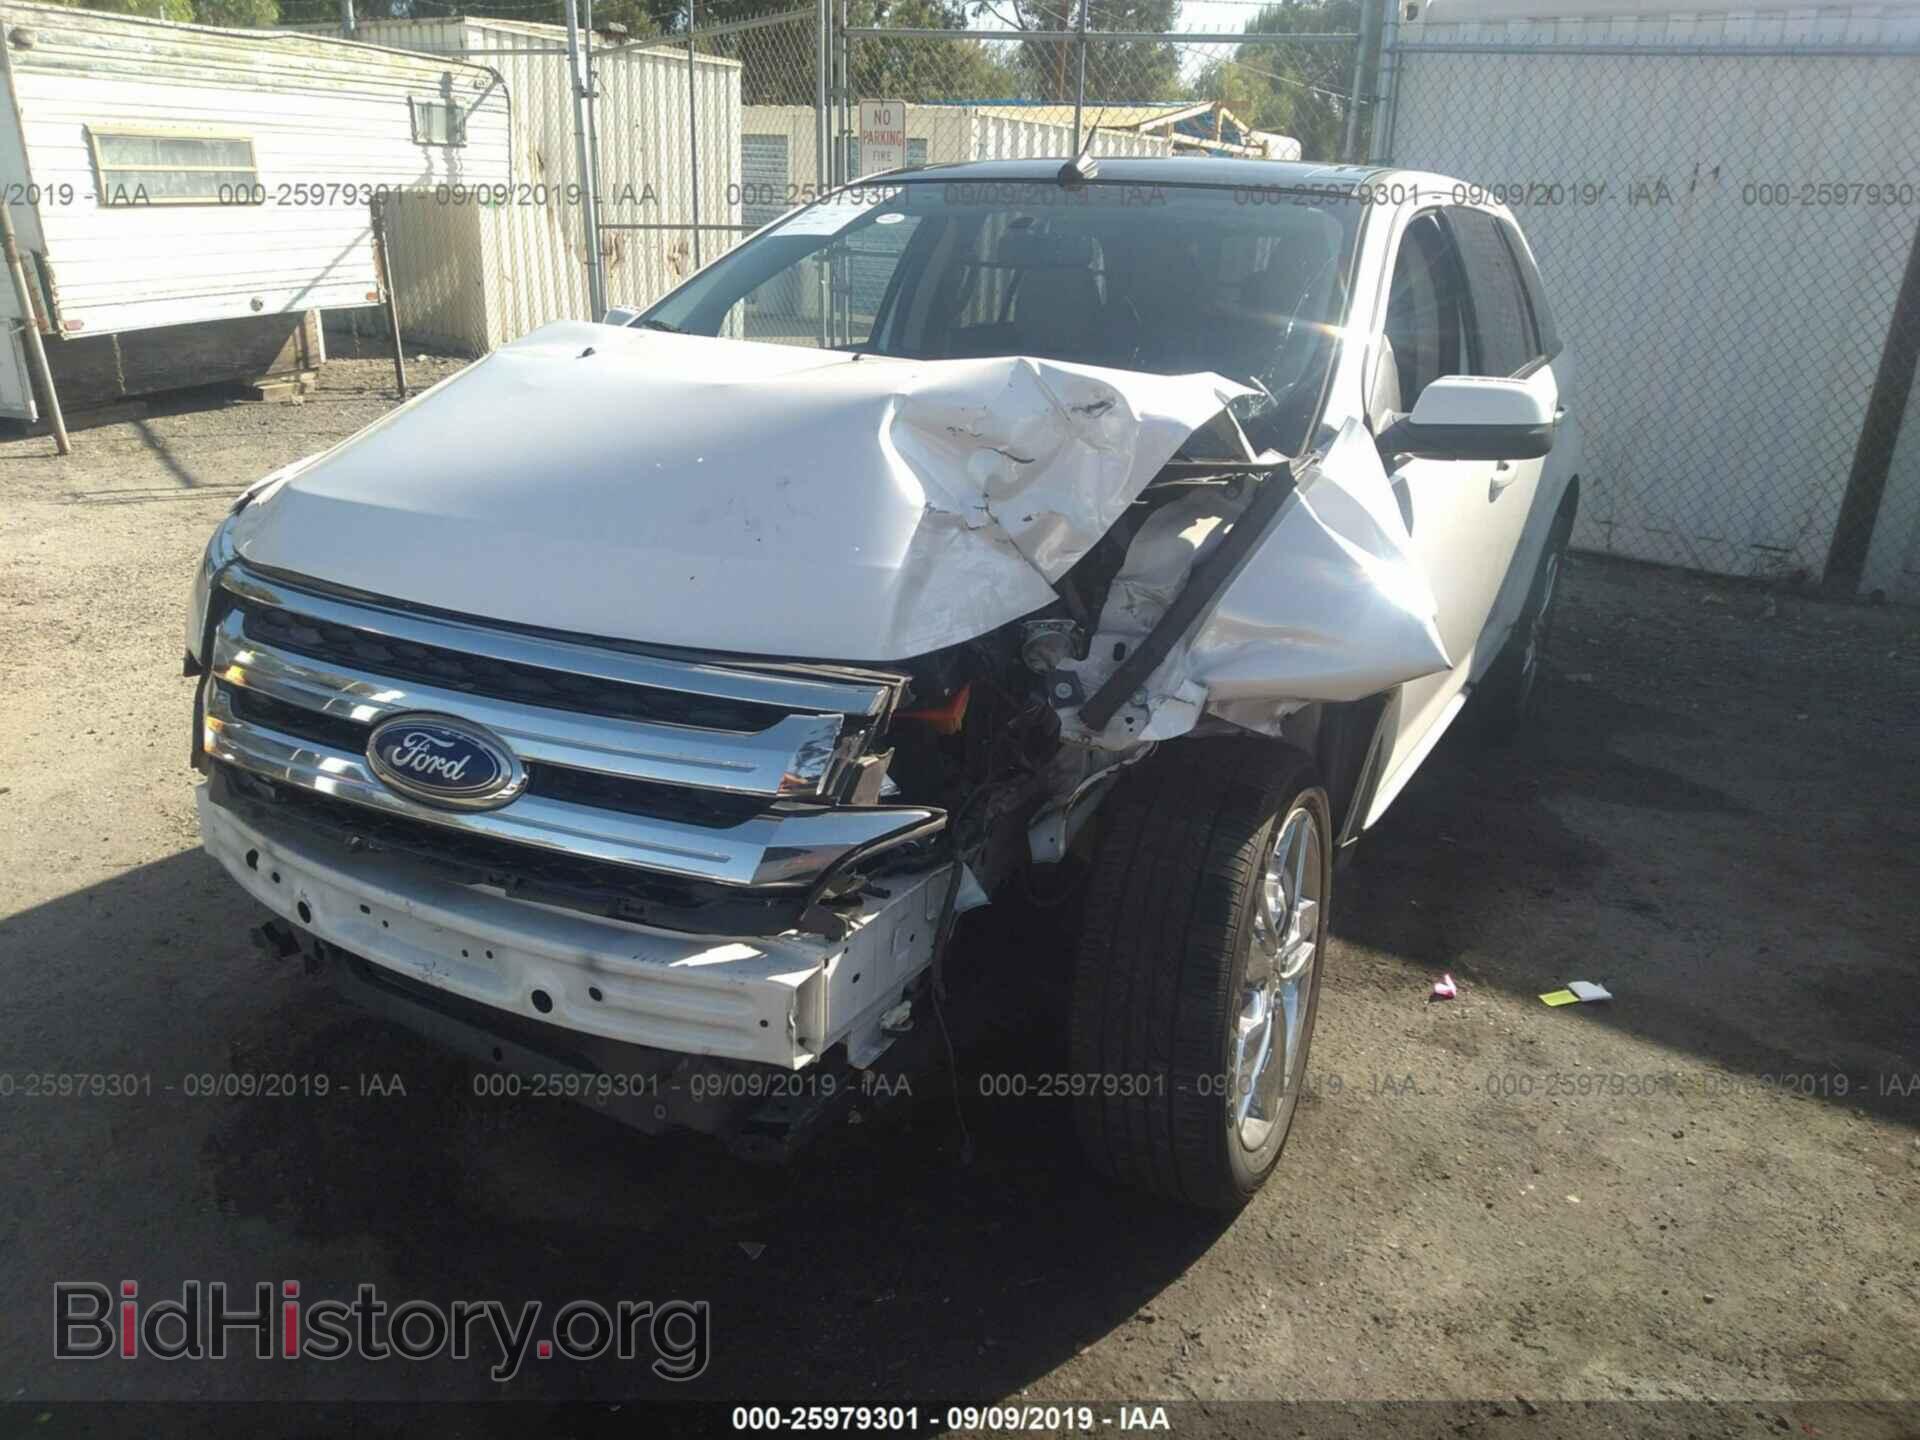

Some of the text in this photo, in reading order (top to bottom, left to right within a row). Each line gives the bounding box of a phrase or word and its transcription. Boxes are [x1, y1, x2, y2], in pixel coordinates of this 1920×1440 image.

[874, 109, 891, 126] NO
[863, 131, 902, 146] PARKING
[391, 732, 472, 781] Ford
